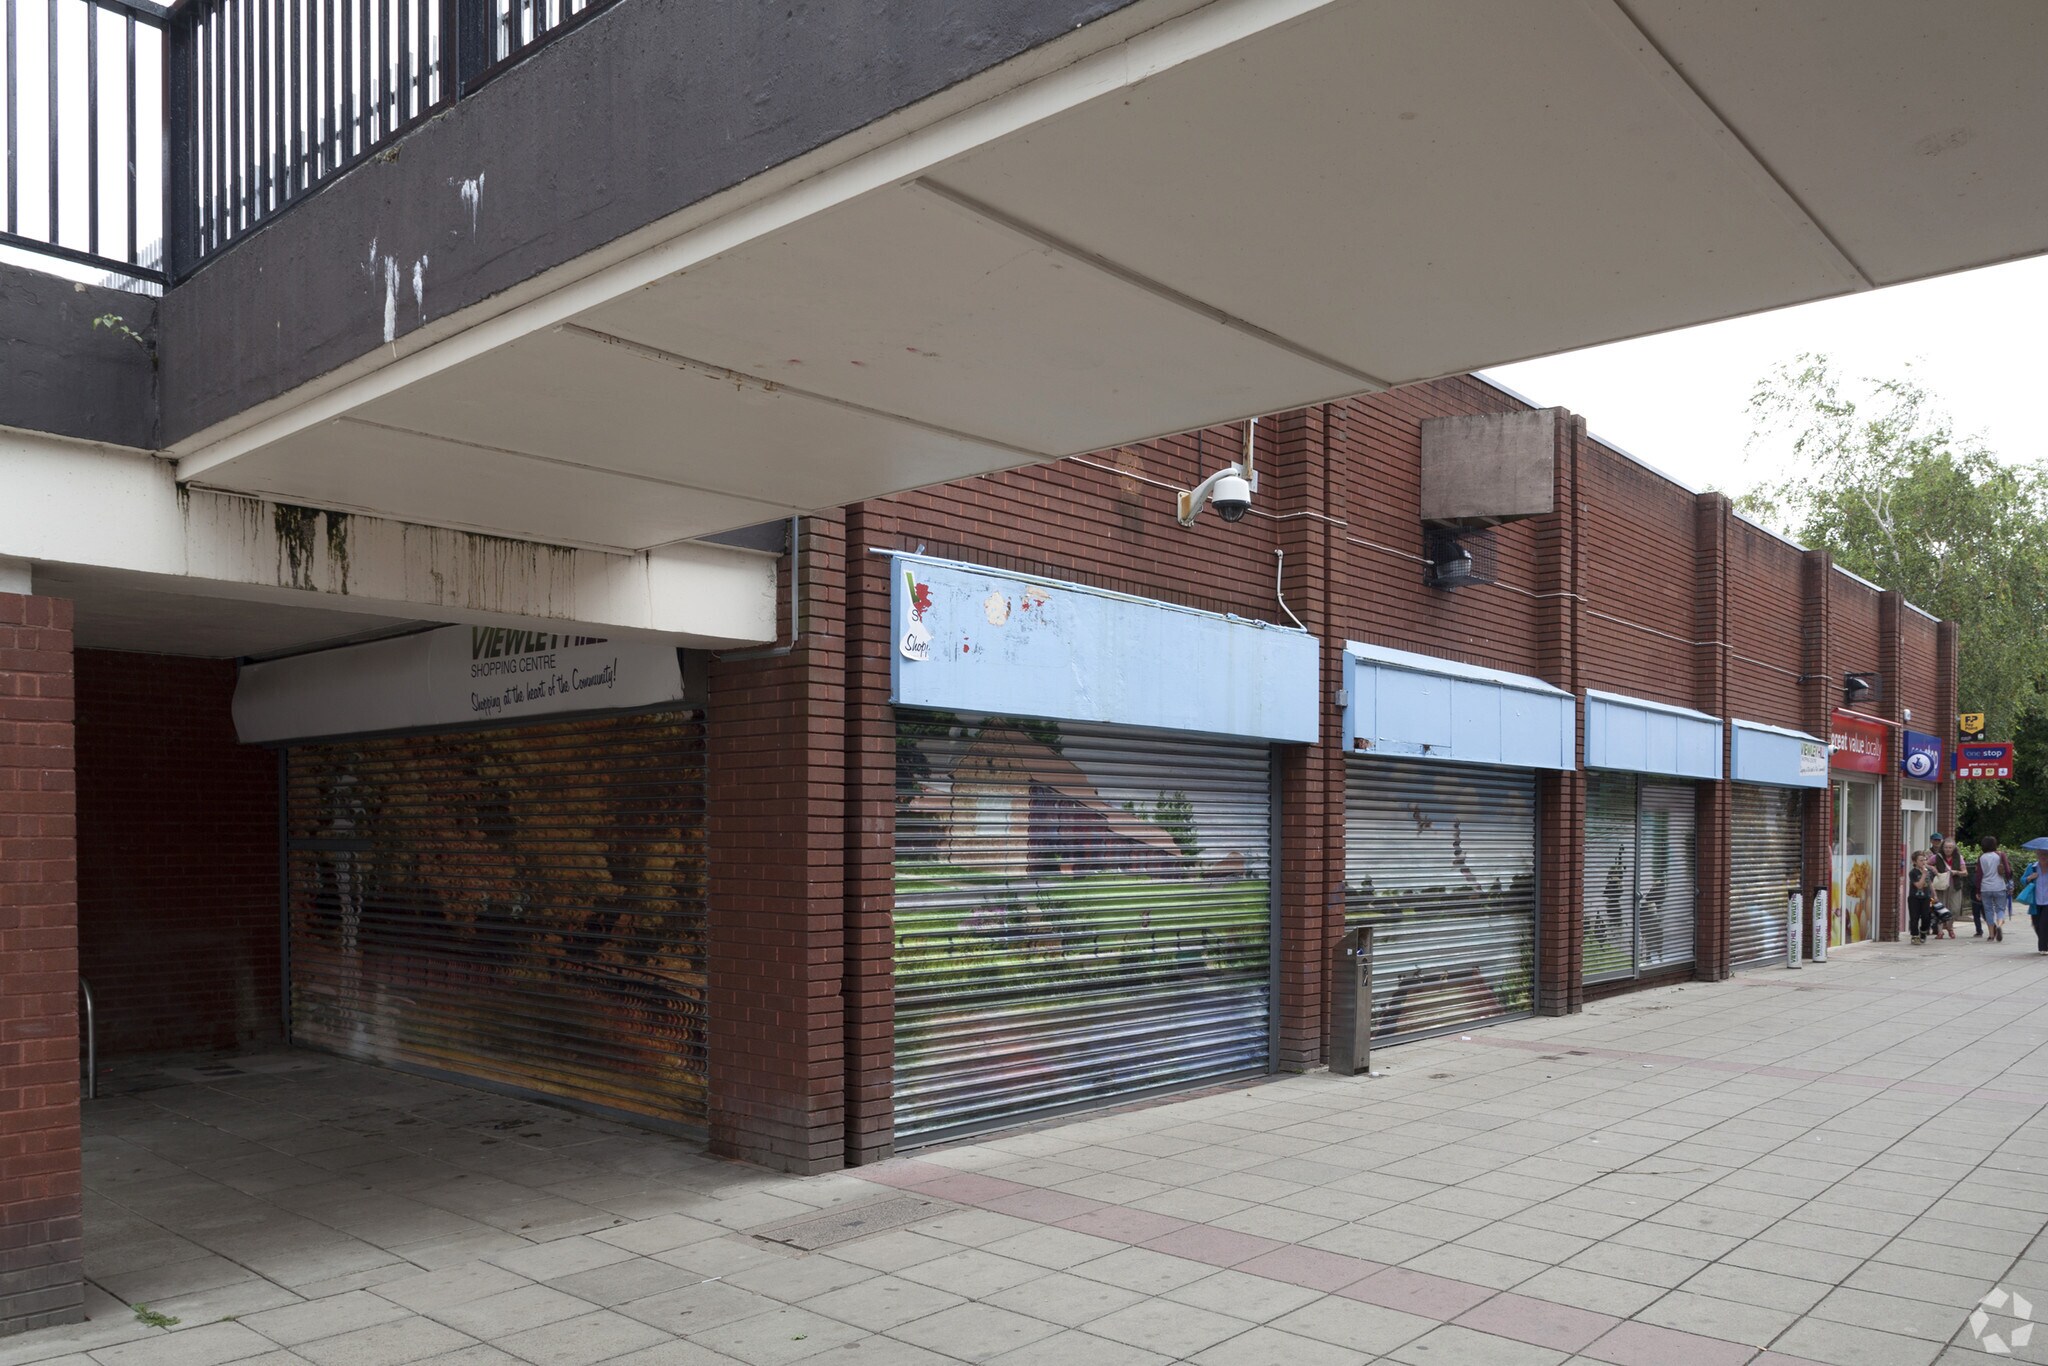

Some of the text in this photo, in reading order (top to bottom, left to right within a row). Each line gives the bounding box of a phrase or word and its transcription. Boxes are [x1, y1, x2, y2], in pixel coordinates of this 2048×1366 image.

[471, 654, 556, 678] SHOPPING CENTRE
[471, 657, 618, 716] Shopping at the heart of the Community!
[1849, 733, 1864, 754] value
[1865, 736, 1882, 760] locally
[1983, 750, 2002, 758] stop
